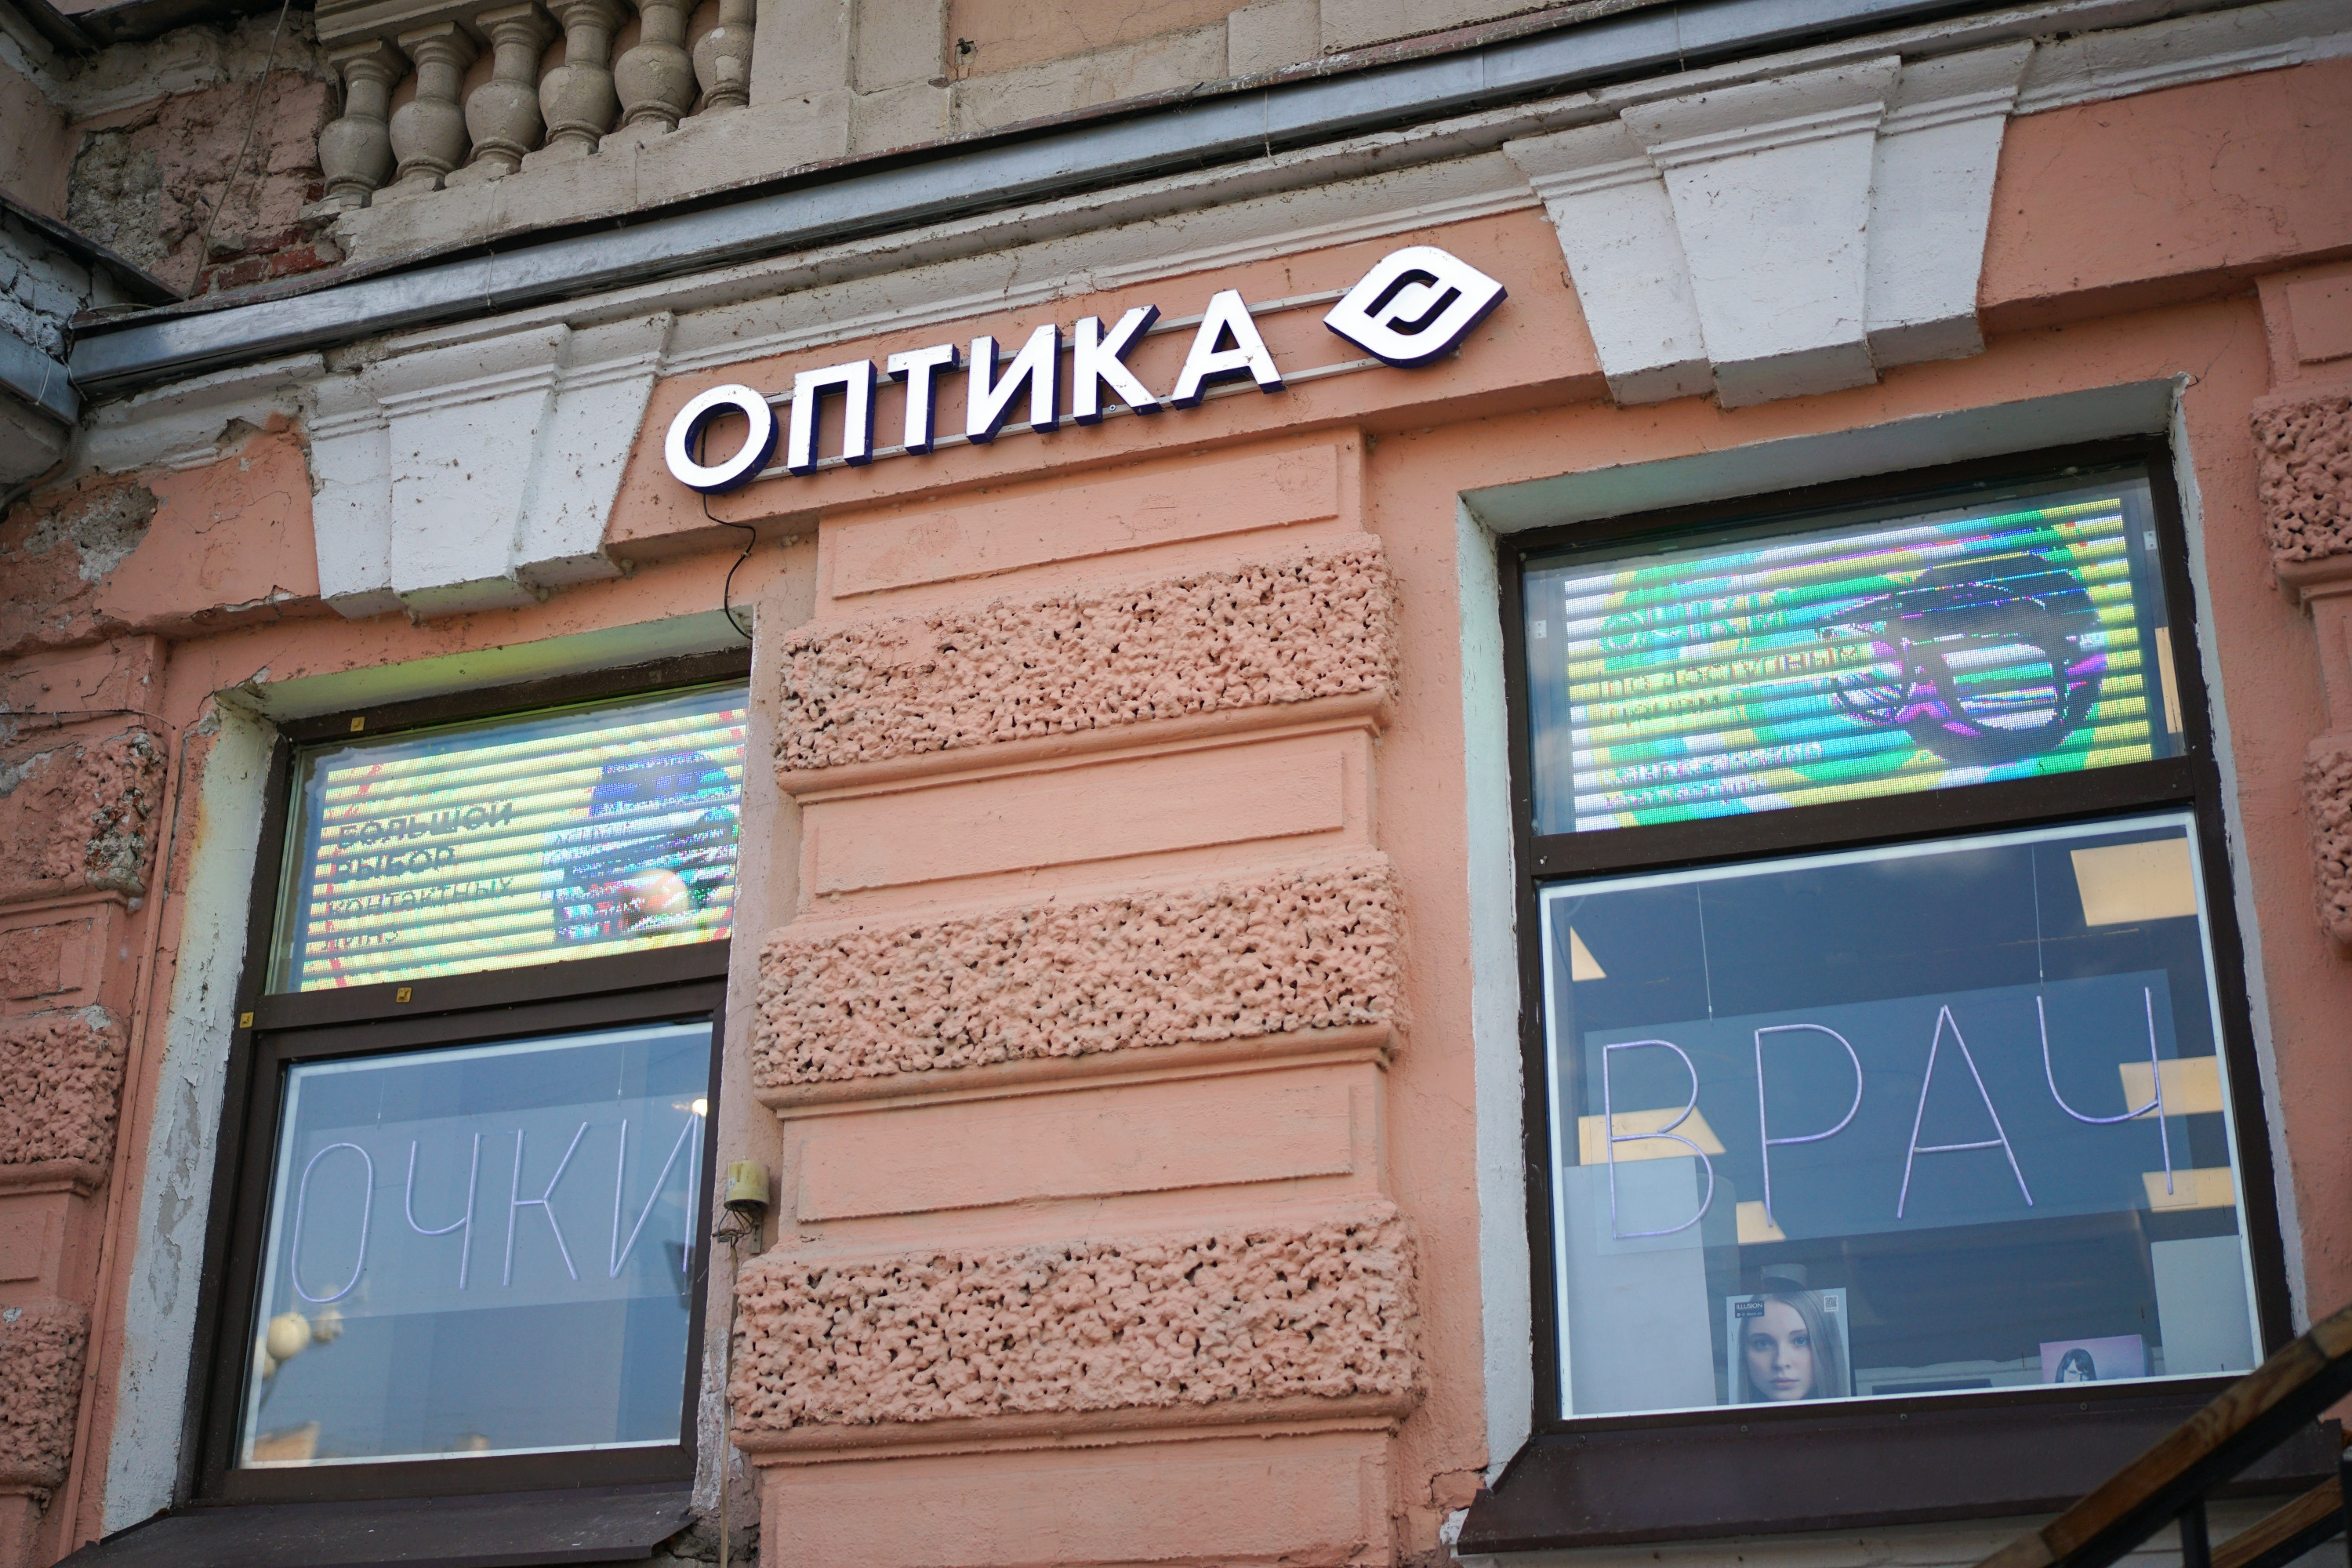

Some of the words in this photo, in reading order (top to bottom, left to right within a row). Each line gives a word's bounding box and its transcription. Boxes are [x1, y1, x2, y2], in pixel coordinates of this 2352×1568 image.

[664, 289, 1287, 495] ОПТИКА
[291, 1112, 701, 1305] ОЧКИ
[1602, 986, 2175, 1241] ВРАЧ
[1736, 1301, 1763, 1310] ILLUSION
